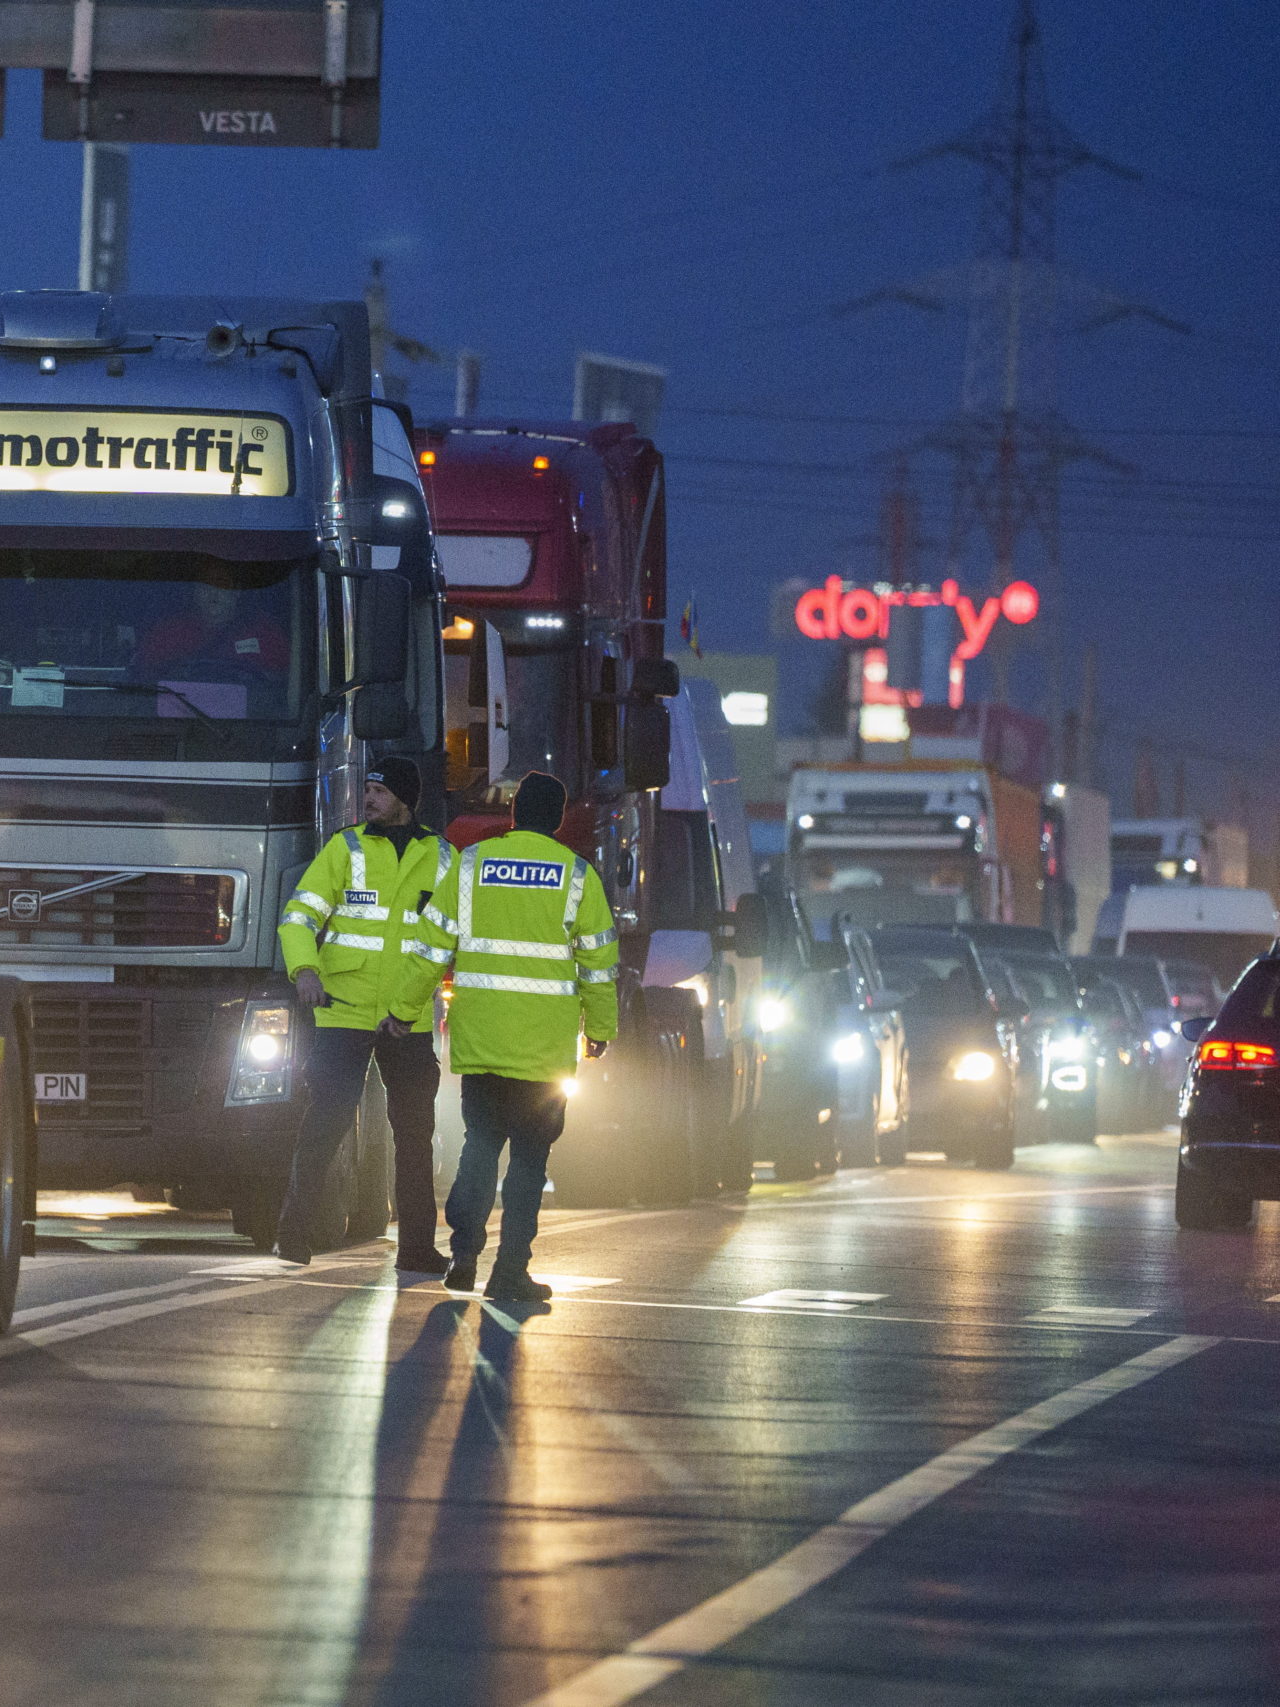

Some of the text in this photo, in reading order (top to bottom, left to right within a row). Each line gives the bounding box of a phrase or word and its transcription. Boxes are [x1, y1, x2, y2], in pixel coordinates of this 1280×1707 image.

[199, 110, 276, 133] VESTA
[483, 864, 559, 883] POLITIA
[44, 1076, 80, 1097] PIN
